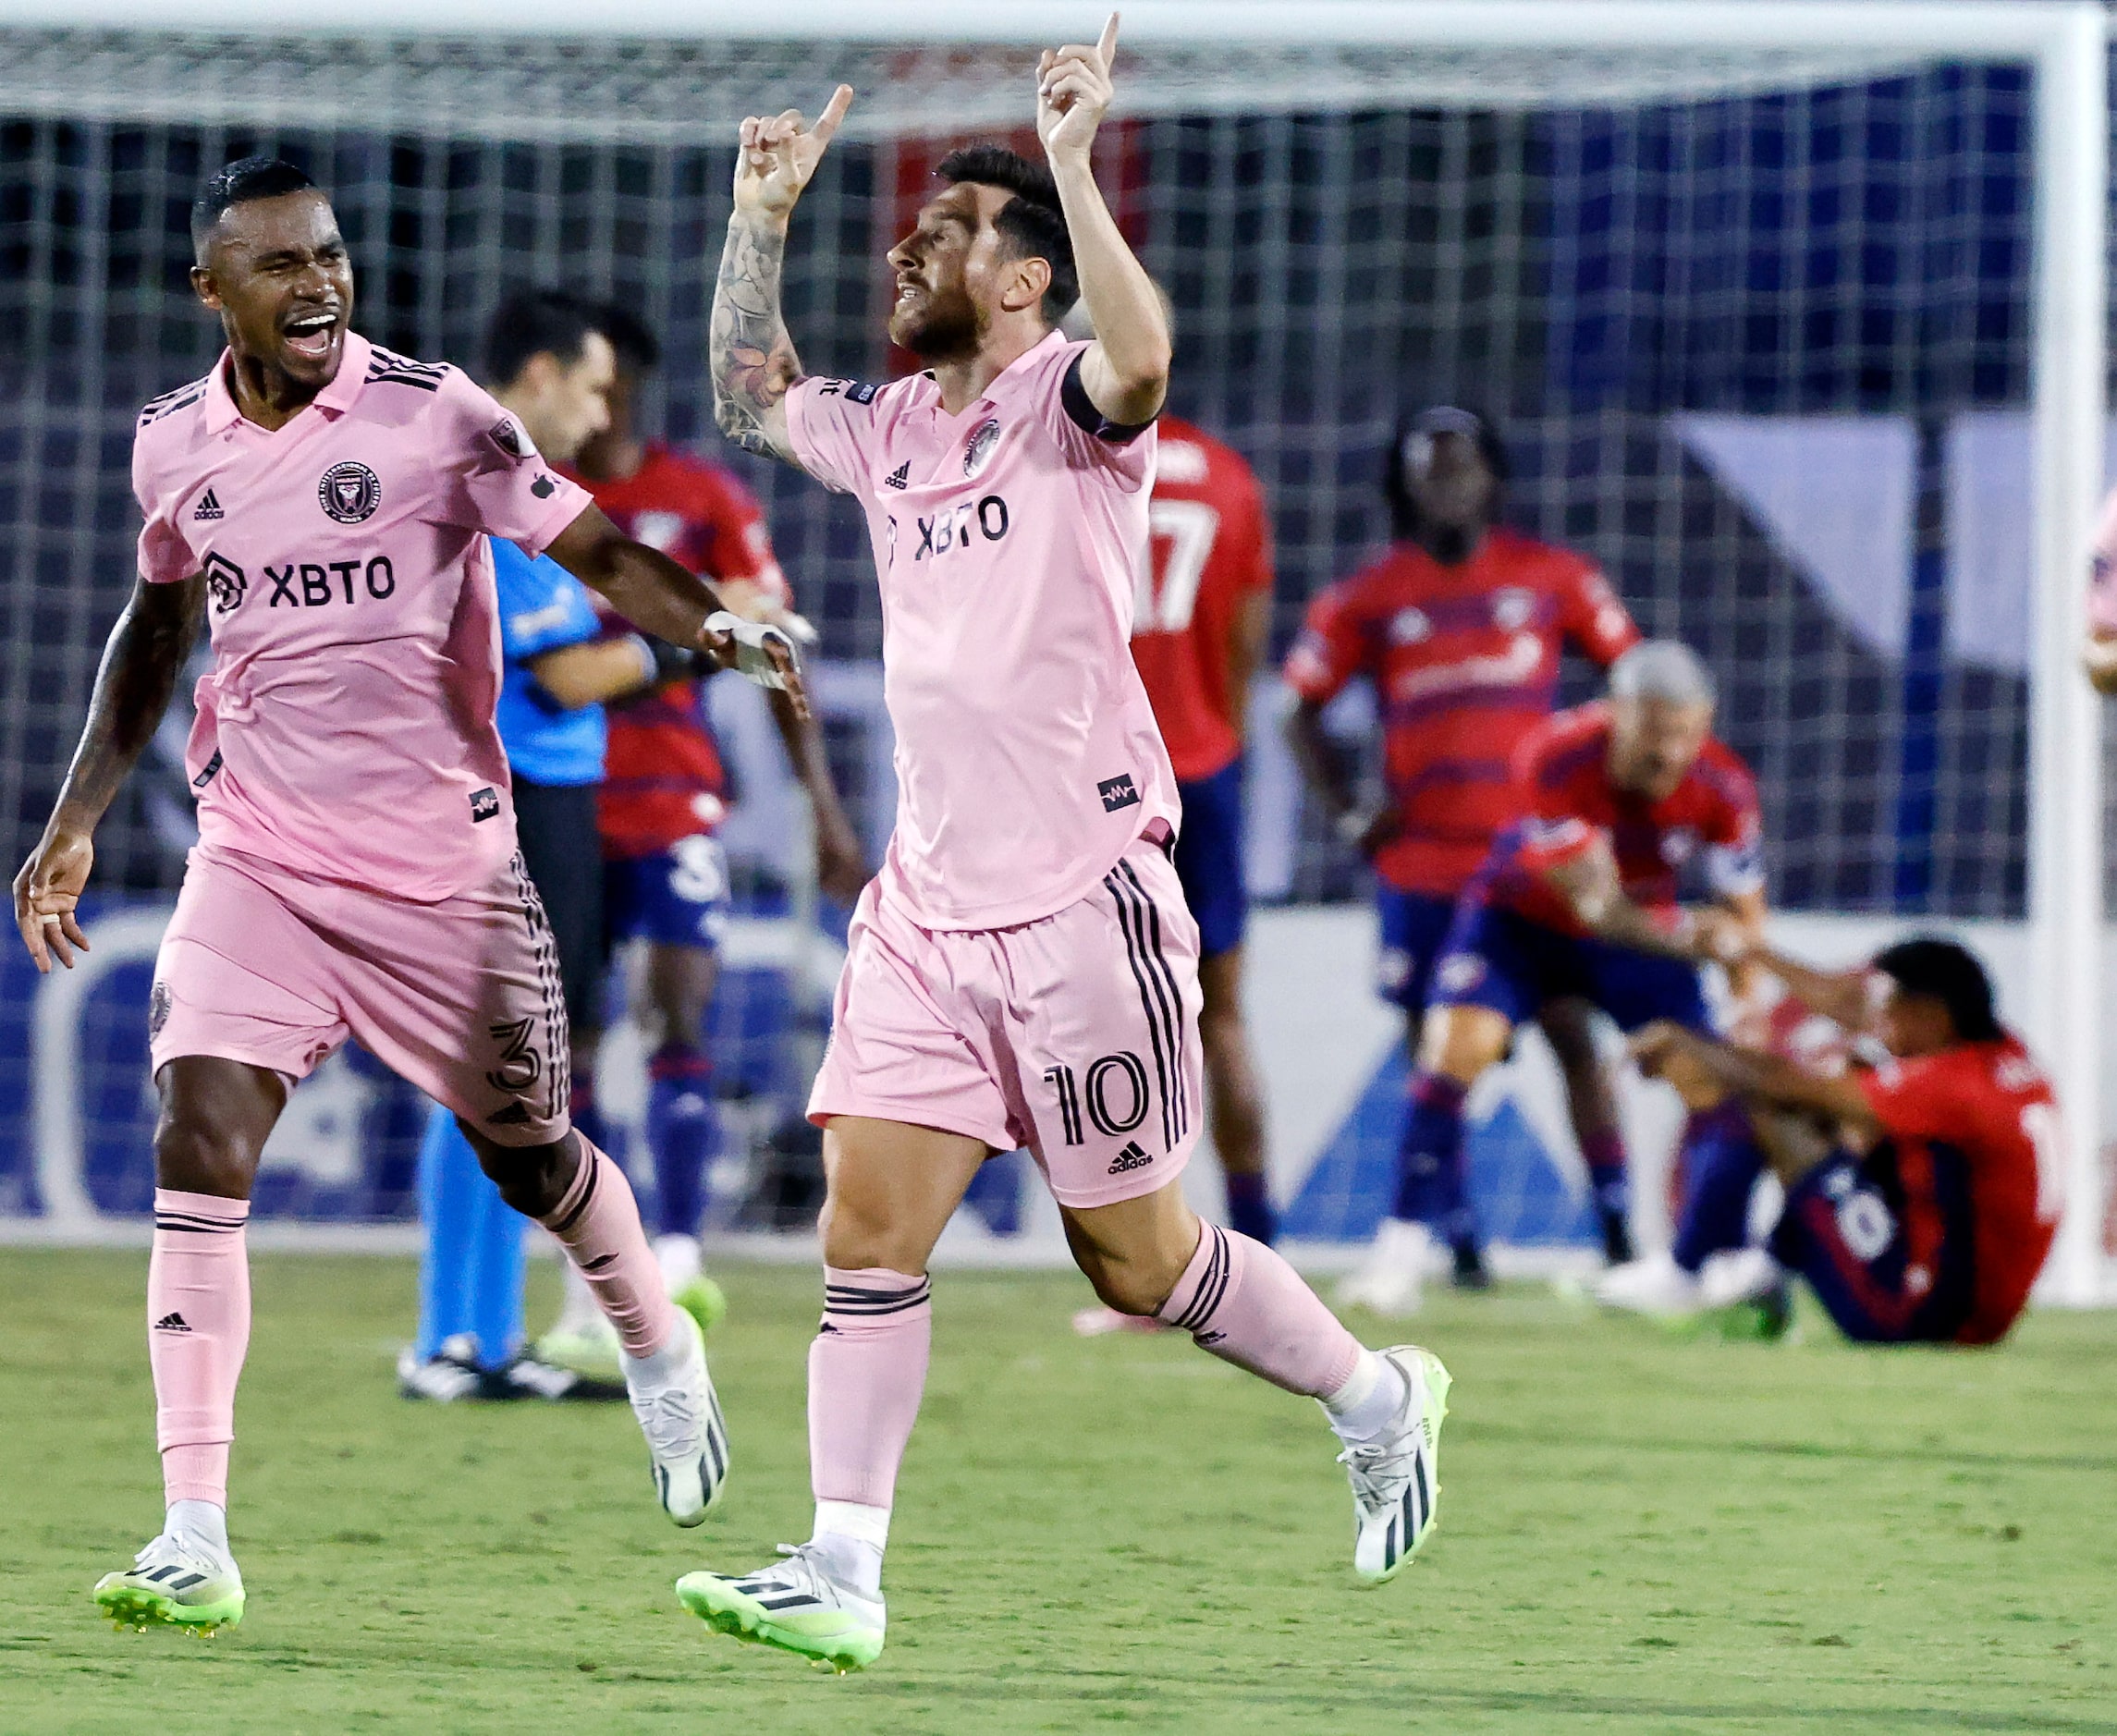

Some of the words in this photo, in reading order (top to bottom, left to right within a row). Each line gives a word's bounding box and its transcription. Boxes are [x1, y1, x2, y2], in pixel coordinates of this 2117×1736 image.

[914, 495, 1009, 560] XBTO
[263, 556, 395, 607] XBTO
[485, 1017, 541, 1094] 3
[1044, 1050, 1149, 1145] 10
[1107, 1155, 1153, 1175] adidas
